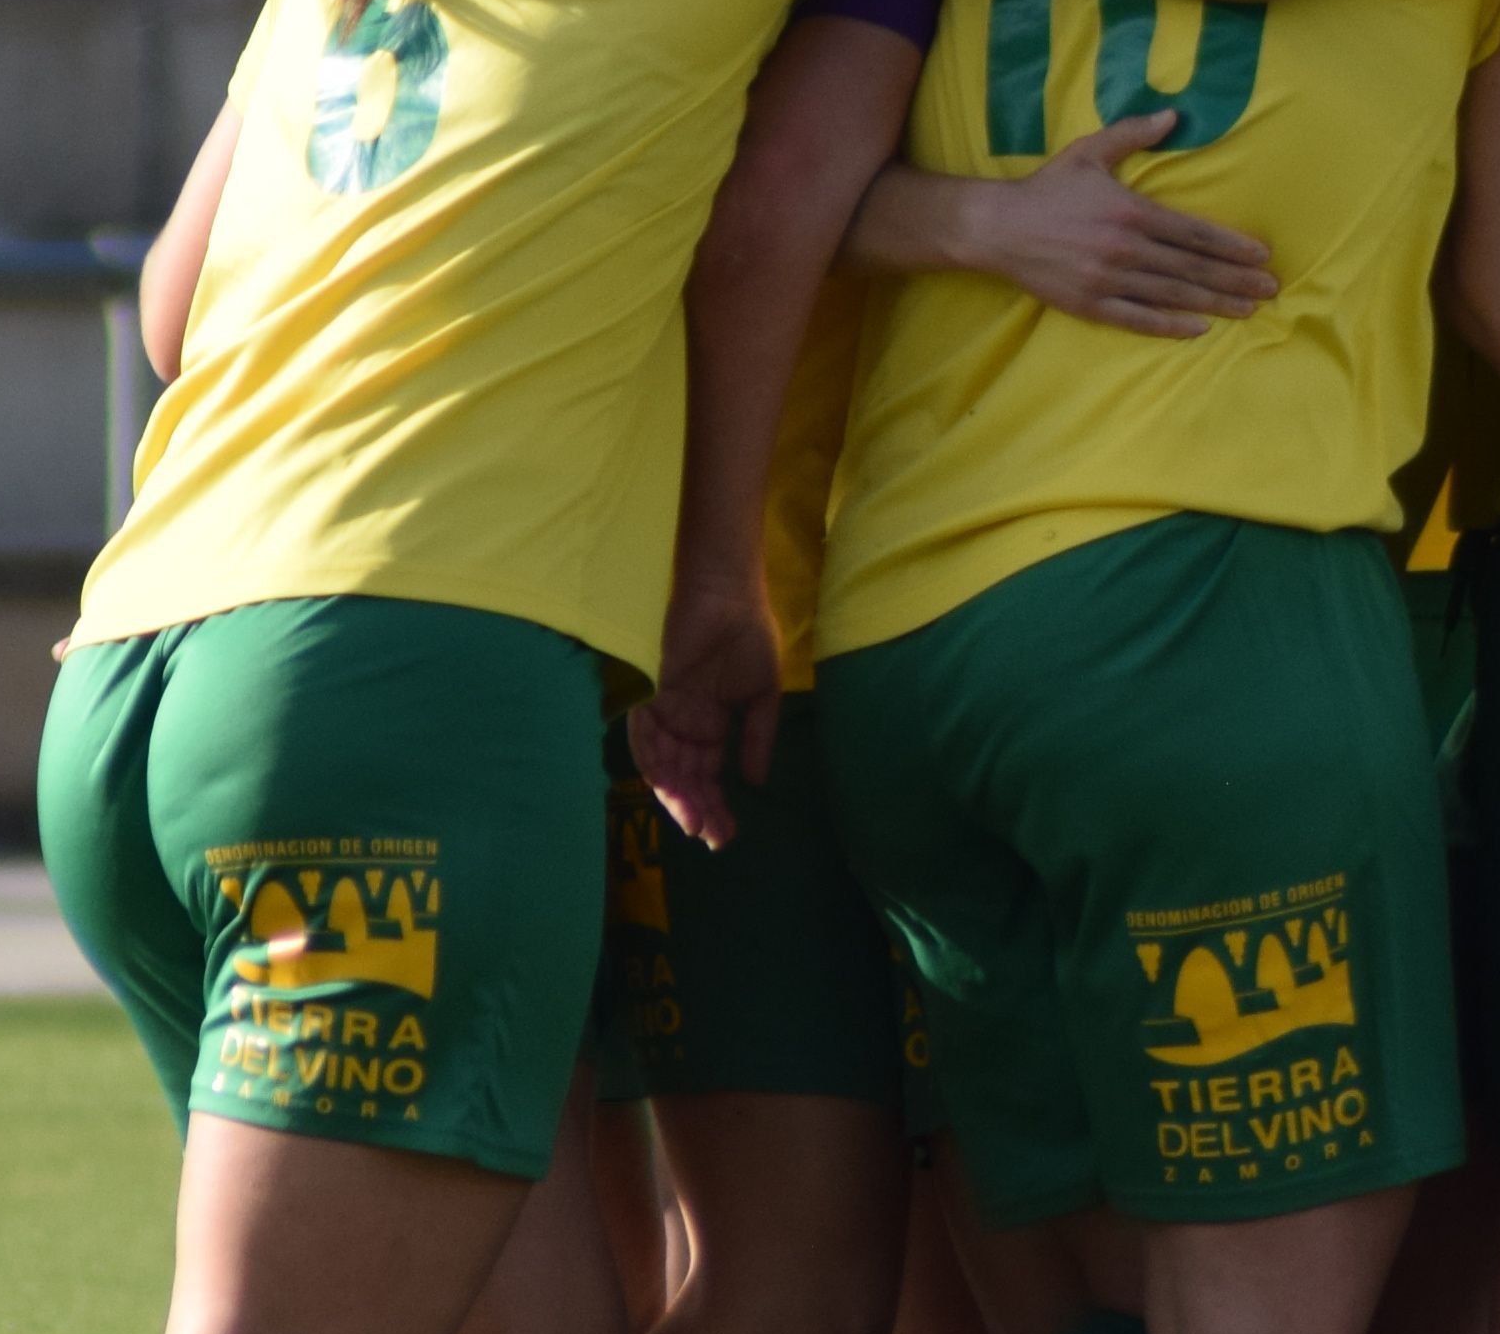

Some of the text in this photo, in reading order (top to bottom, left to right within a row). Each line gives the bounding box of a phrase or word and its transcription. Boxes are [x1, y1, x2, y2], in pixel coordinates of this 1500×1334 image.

[339, 837, 361, 855] DE
[371, 838, 438, 857] ORIGEN
[1259, 891, 1281, 910] DE
[1287, 872, 1346, 903] ORIGEN
[230, 984, 426, 1051] TIERRA
[1149, 1045, 1361, 1114] TIERRA
[1163, 1130, 1376, 1183] ZAMORA
